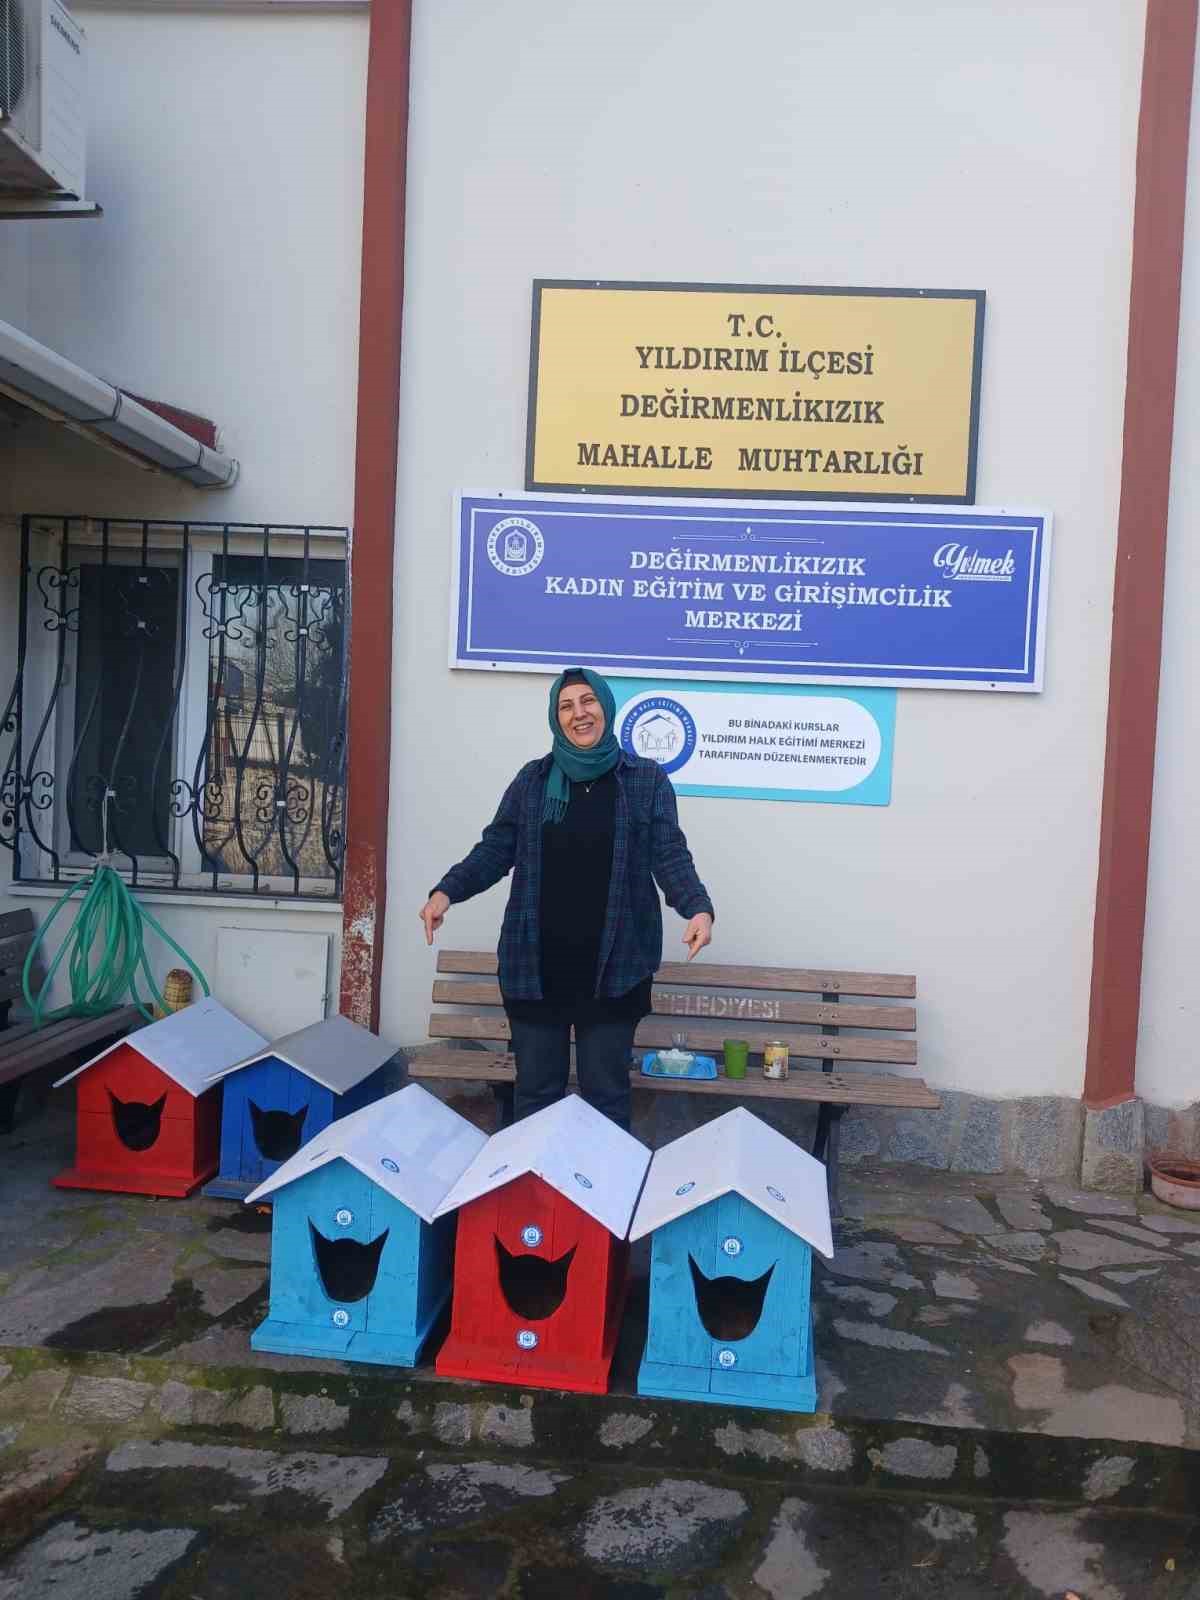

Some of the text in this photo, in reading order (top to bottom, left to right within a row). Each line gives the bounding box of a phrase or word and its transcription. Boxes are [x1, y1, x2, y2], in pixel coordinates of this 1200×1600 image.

[728, 314, 781, 338] T.C.
[636, 342, 874, 380] YILDIRIM İLÇESİ
[620, 388, 884, 424] DEĞİRMENLİKIZIK
[577, 443, 923, 475] MAHALLE MUHTARLIĞI
[630, 548, 865, 575] DEĞİRMENLİKIZIK
[545, 576, 952, 609] KADIN EĞİTİM VE GİRİŞİMCİLİK
[685, 610, 802, 631] MERKEZİ
[744, 719, 792, 729] BİNADAKİ
[794, 722, 839, 732] KURSLAR
[702, 734, 865, 749] YILDIRIM HALK EĞİTİMİ MERKEZİ
[699, 750, 866, 765] TARAFINDAN DÜZENLENMEKTEDİR
